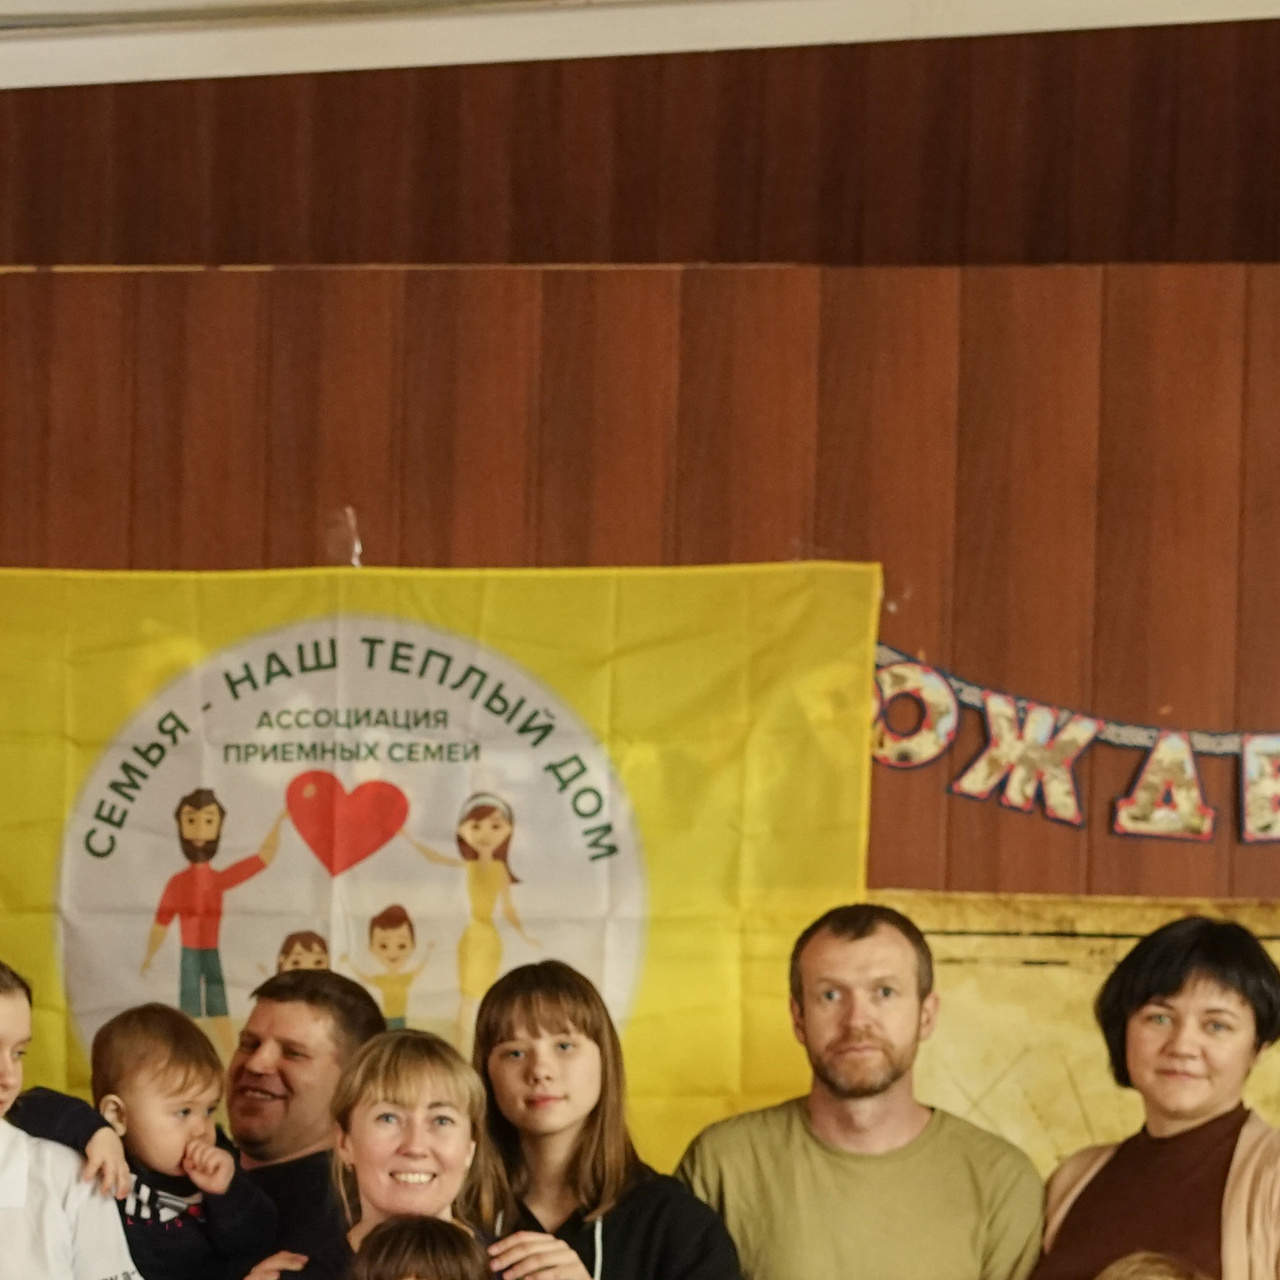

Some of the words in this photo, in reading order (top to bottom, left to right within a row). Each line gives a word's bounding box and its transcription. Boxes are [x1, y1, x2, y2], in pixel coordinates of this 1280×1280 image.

[84, 709, 191, 859] СЕМЬЯ
[223, 638, 338, 699] НАШ
[360, 636, 555, 747] ТЕПЛЫЙ
[543, 754, 619, 863] ДОМ
[223, 742, 380, 763] ПРИЕМНЫХ
[387, 740, 481, 763] СЕМЕЙ
[256, 709, 449, 731] АССОЦИАЦИЯ
[872, 661, 1280, 843] ОЖДЕ
